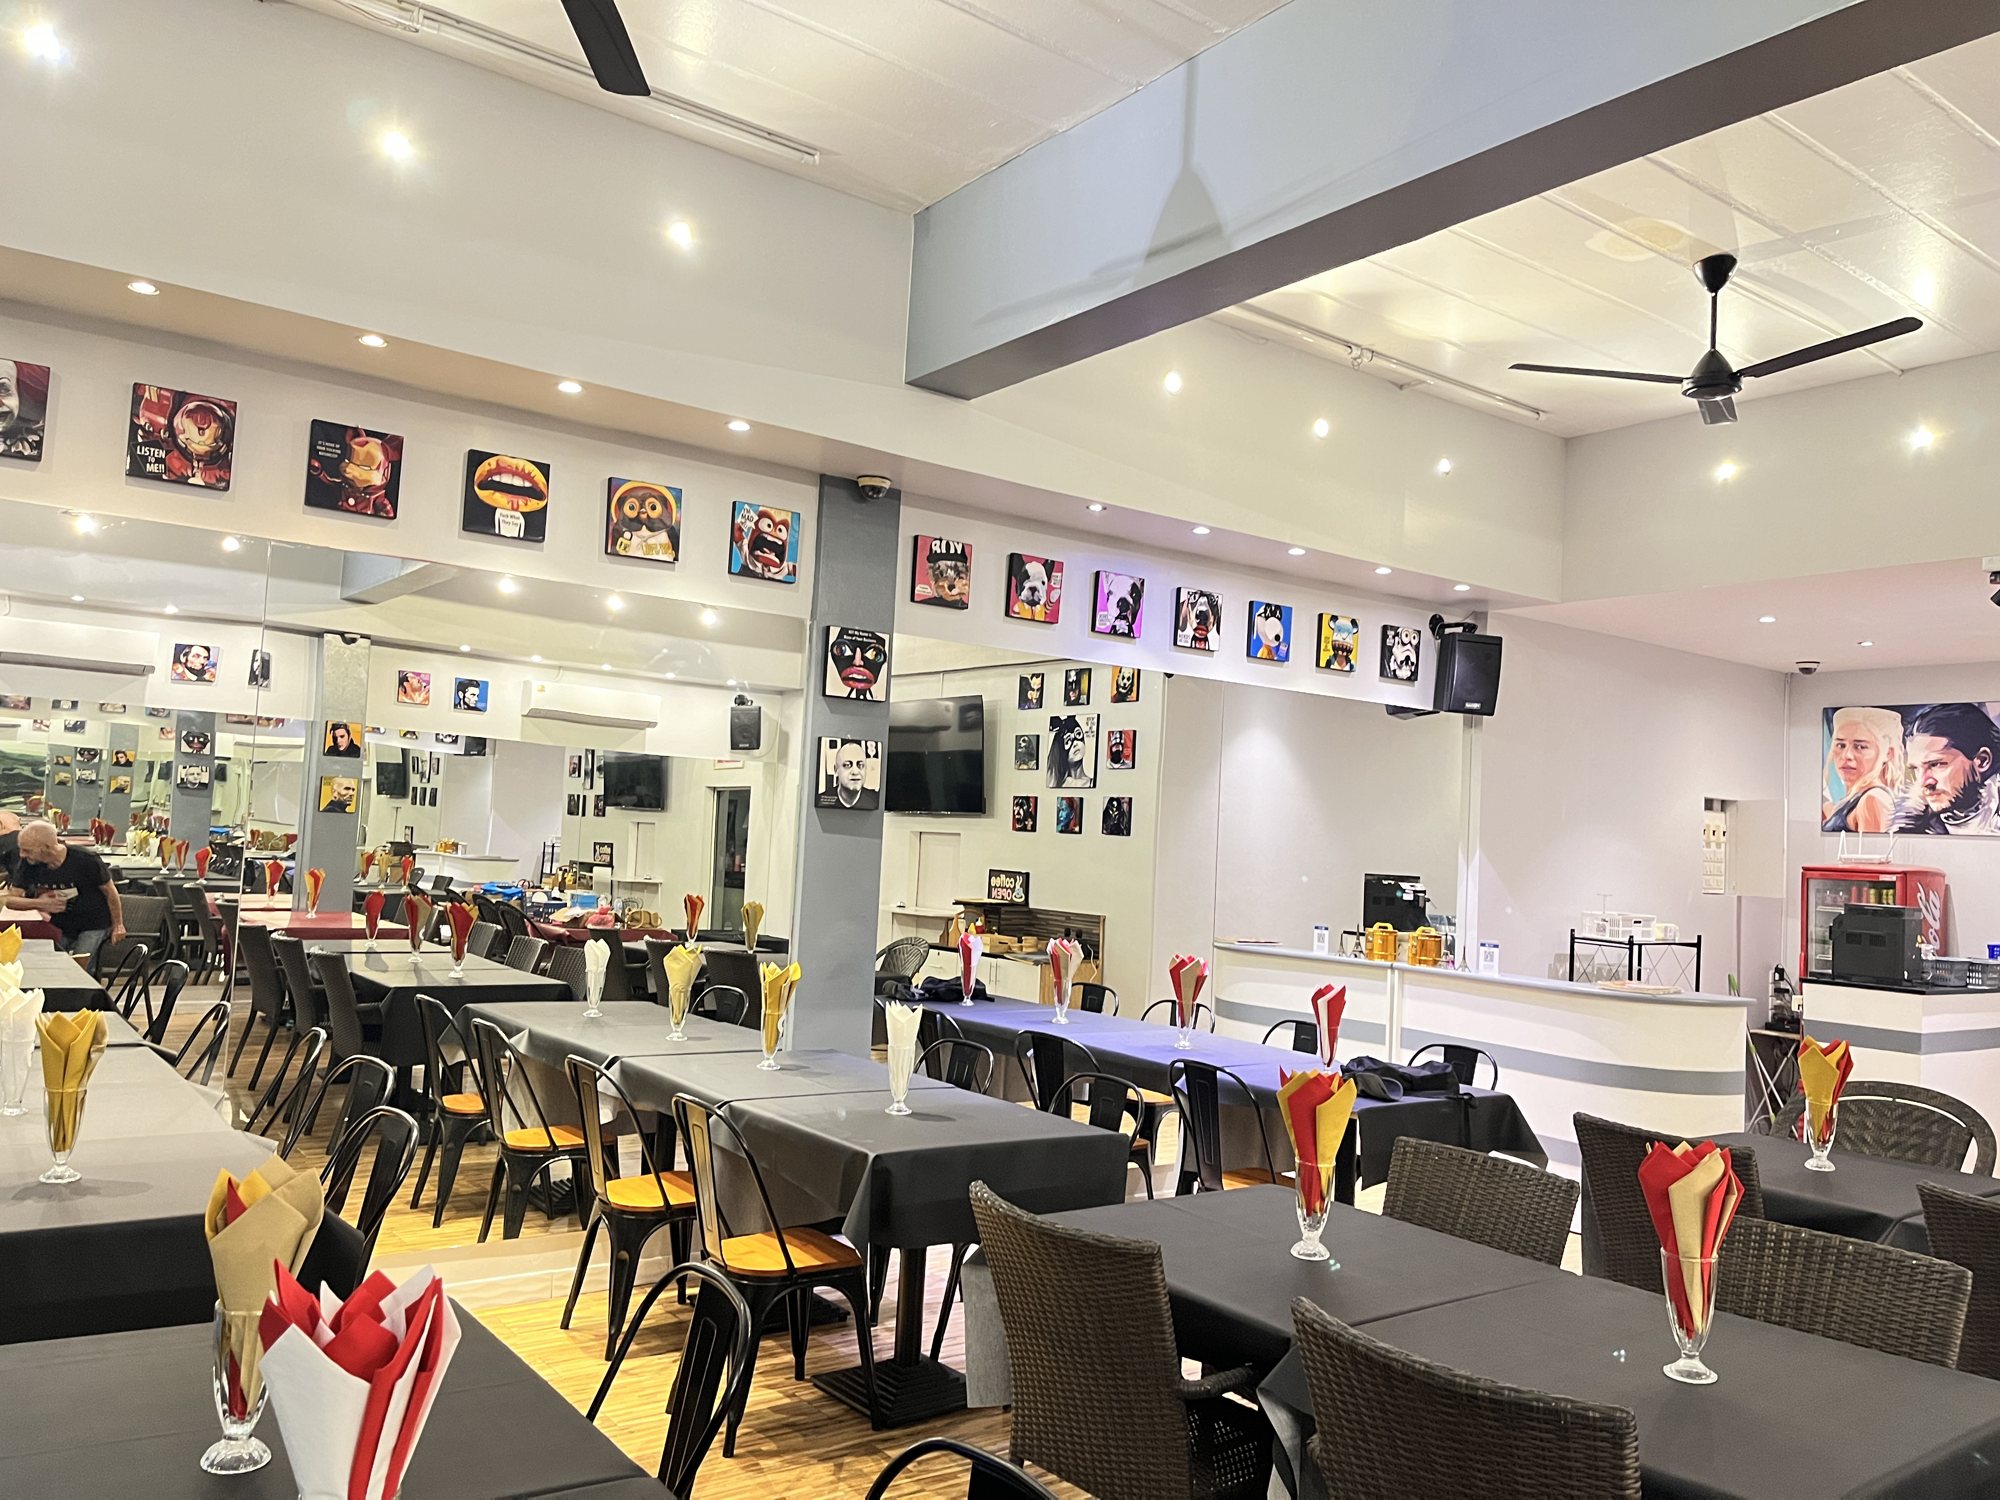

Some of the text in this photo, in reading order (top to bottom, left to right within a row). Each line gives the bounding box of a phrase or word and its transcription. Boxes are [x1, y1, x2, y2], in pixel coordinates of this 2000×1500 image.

[136, 445, 166, 459] LISTEN
[146, 463, 165, 473] ME!!
[740, 512, 755, 522] MAD
